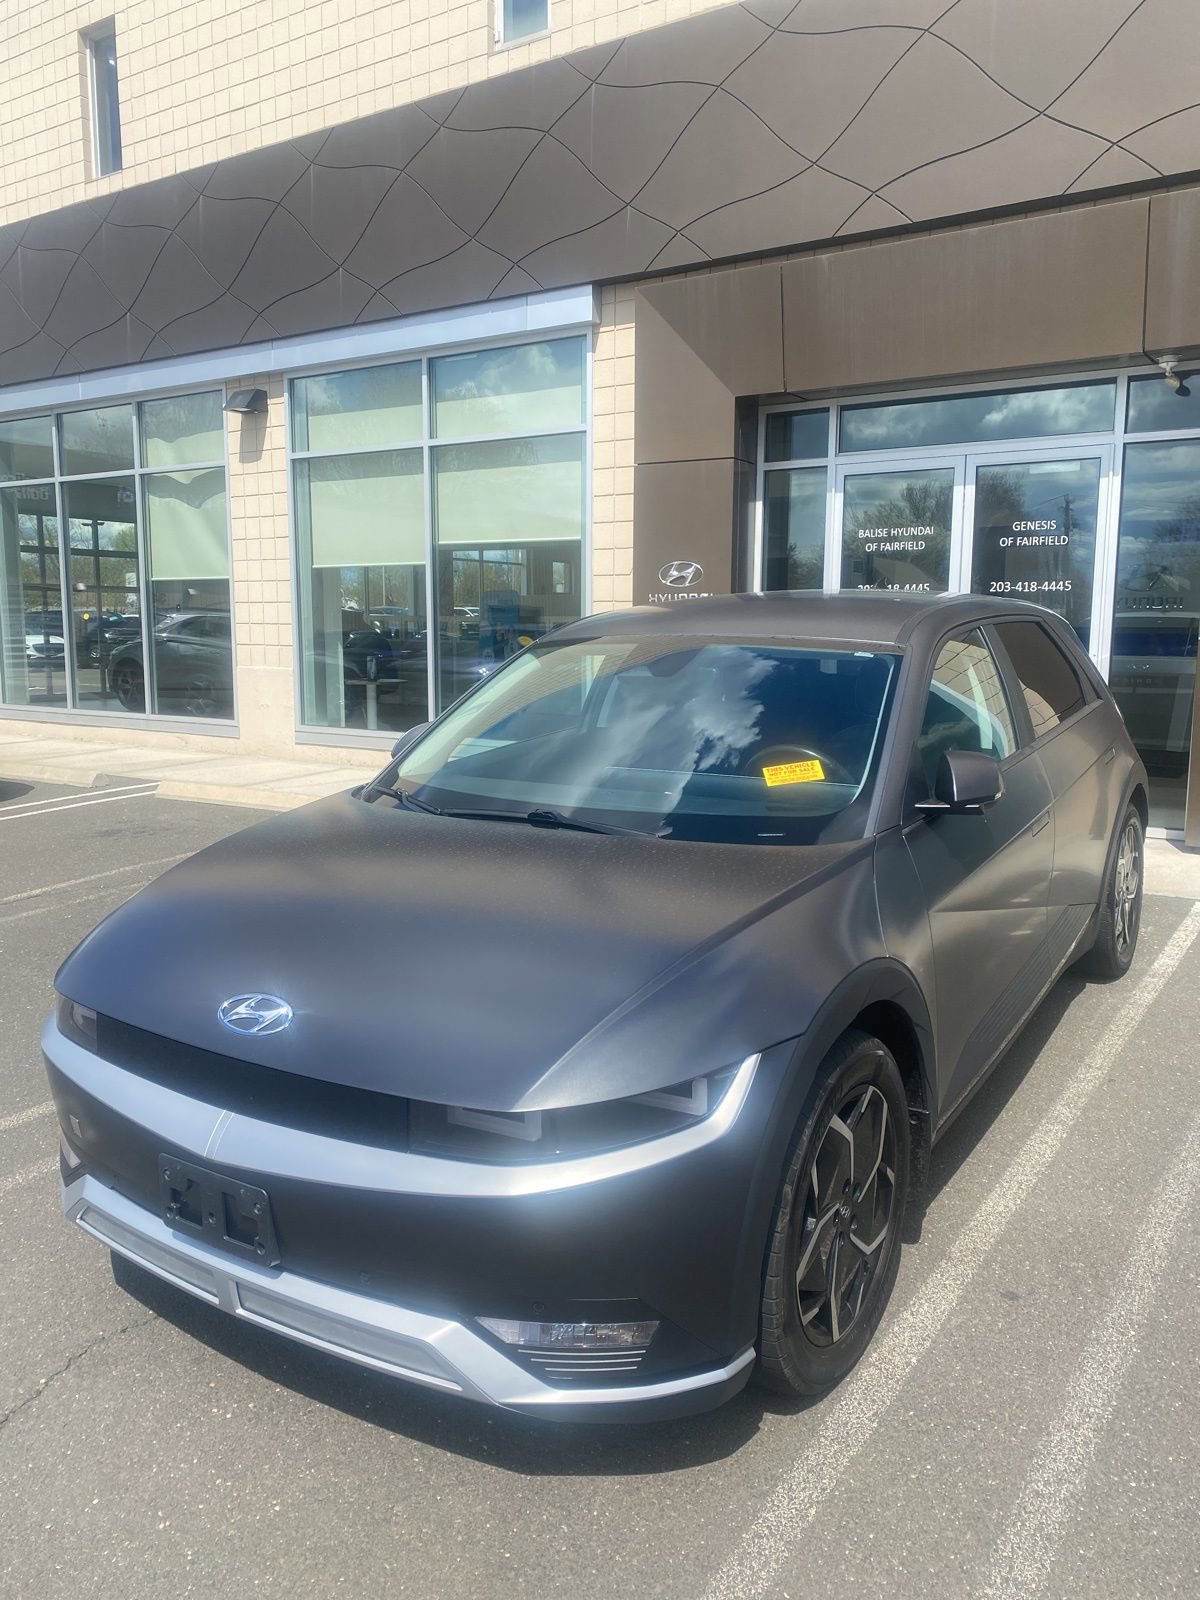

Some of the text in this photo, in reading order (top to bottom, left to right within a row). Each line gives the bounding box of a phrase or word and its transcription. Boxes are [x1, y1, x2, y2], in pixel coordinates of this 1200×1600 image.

[1012, 520, 1057, 531] GENESIS
[858, 526, 934, 538] BALISE HYUNDAI
[865, 541, 926, 552] OF FAIRFIELD
[999, 535, 1069, 547] OF FAIRFIELD
[989, 580, 1072, 592] 203-418-4445
[784, 762, 815, 770] VEHICLE
